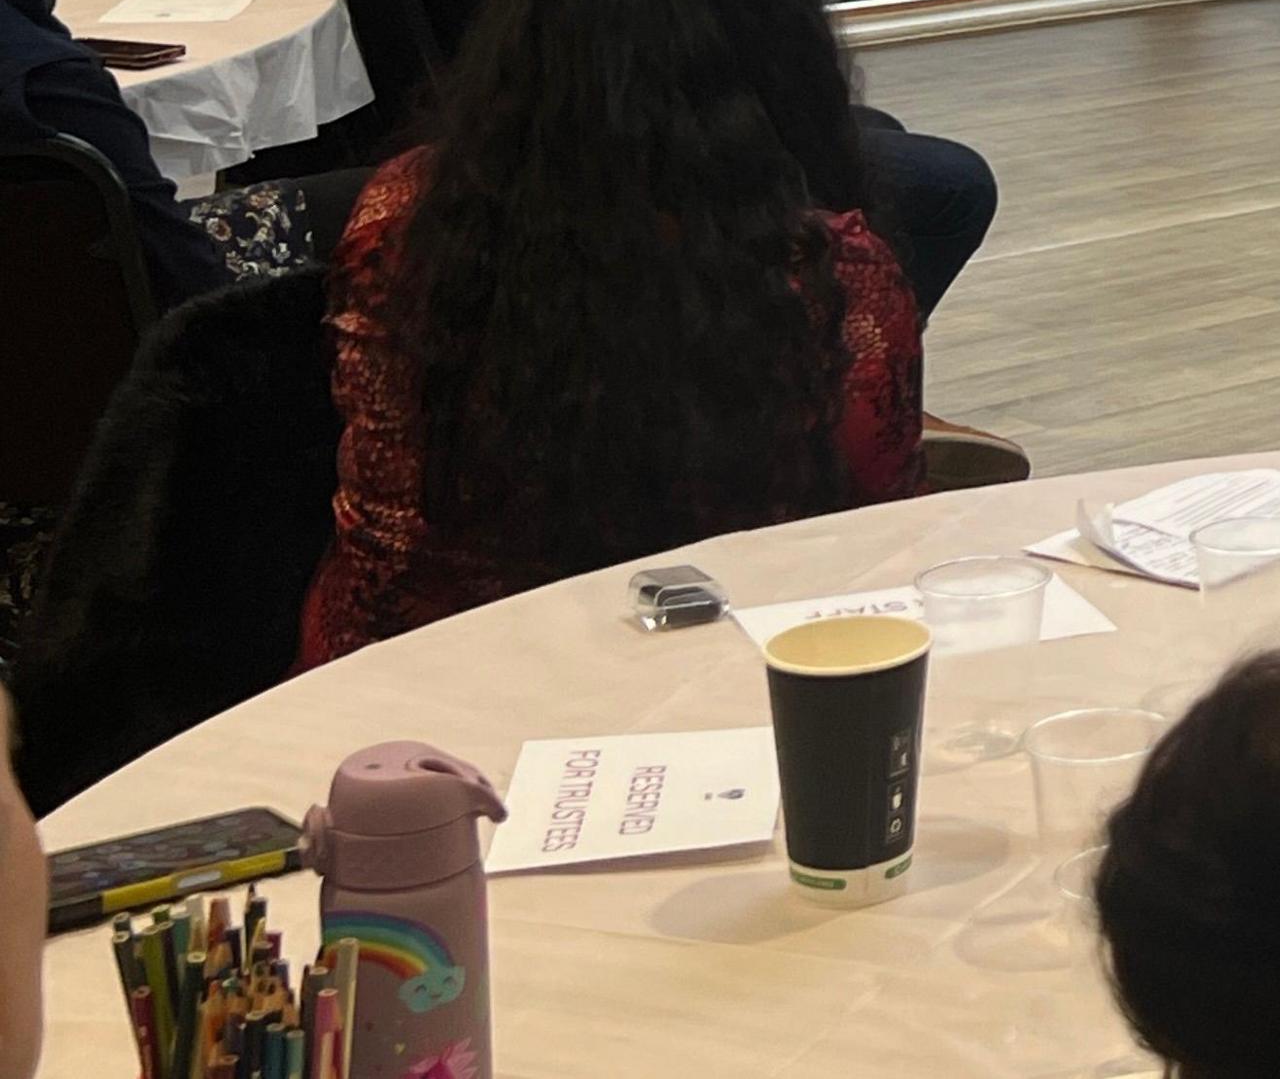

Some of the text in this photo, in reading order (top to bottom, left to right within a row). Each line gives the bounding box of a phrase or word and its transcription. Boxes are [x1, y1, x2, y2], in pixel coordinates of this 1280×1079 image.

[541, 749, 601, 853] FOR TRUSTEES
[619, 765, 666, 836] RESERVED
